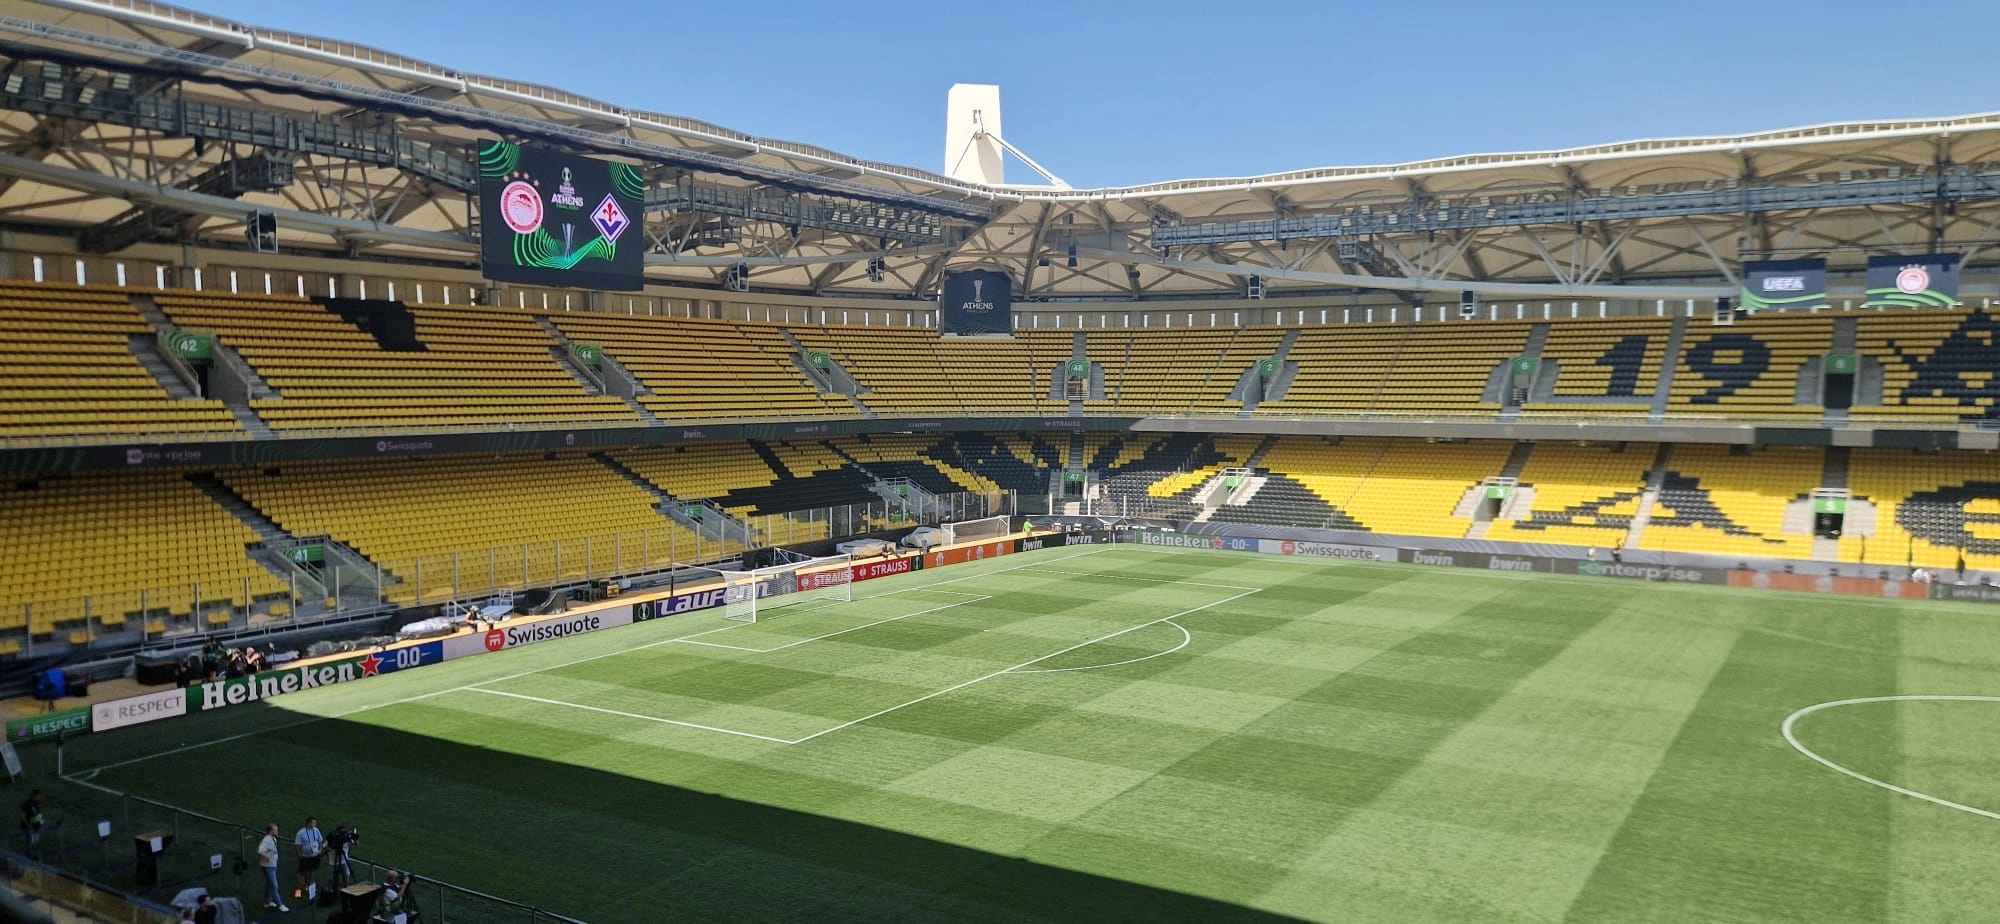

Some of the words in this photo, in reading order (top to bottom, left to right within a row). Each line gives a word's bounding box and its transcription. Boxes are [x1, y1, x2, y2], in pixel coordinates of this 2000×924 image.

[551, 193, 584, 207] ATHENS
[1762, 276, 1804, 291] UEFA
[962, 302, 994, 310] ATHENS
[180, 339, 198, 352] 42
[581, 350, 592, 359] 44
[1070, 473, 1080, 481] 47
[1022, 537, 1043, 551] bwin
[1065, 534, 1093, 545] bwin
[1142, 532, 1210, 548] Heineken
[295, 548, 308, 562] 41
[1297, 542, 1373, 560] Swissquote
[1413, 550, 1454, 566] bwin
[871, 560, 908, 576] STRAUSS
[1489, 556, 1533, 571] bwin
[1586, 561, 1702, 581] enterprise
[814, 570, 854, 587] STRAUSS
[507, 615, 600, 646] Swissquote
[202, 662, 356, 711] Heineken
[397, 646, 420, 669] 0.0
[118, 696, 182, 719] RESPECT
[33, 714, 88, 736] RESPECT
